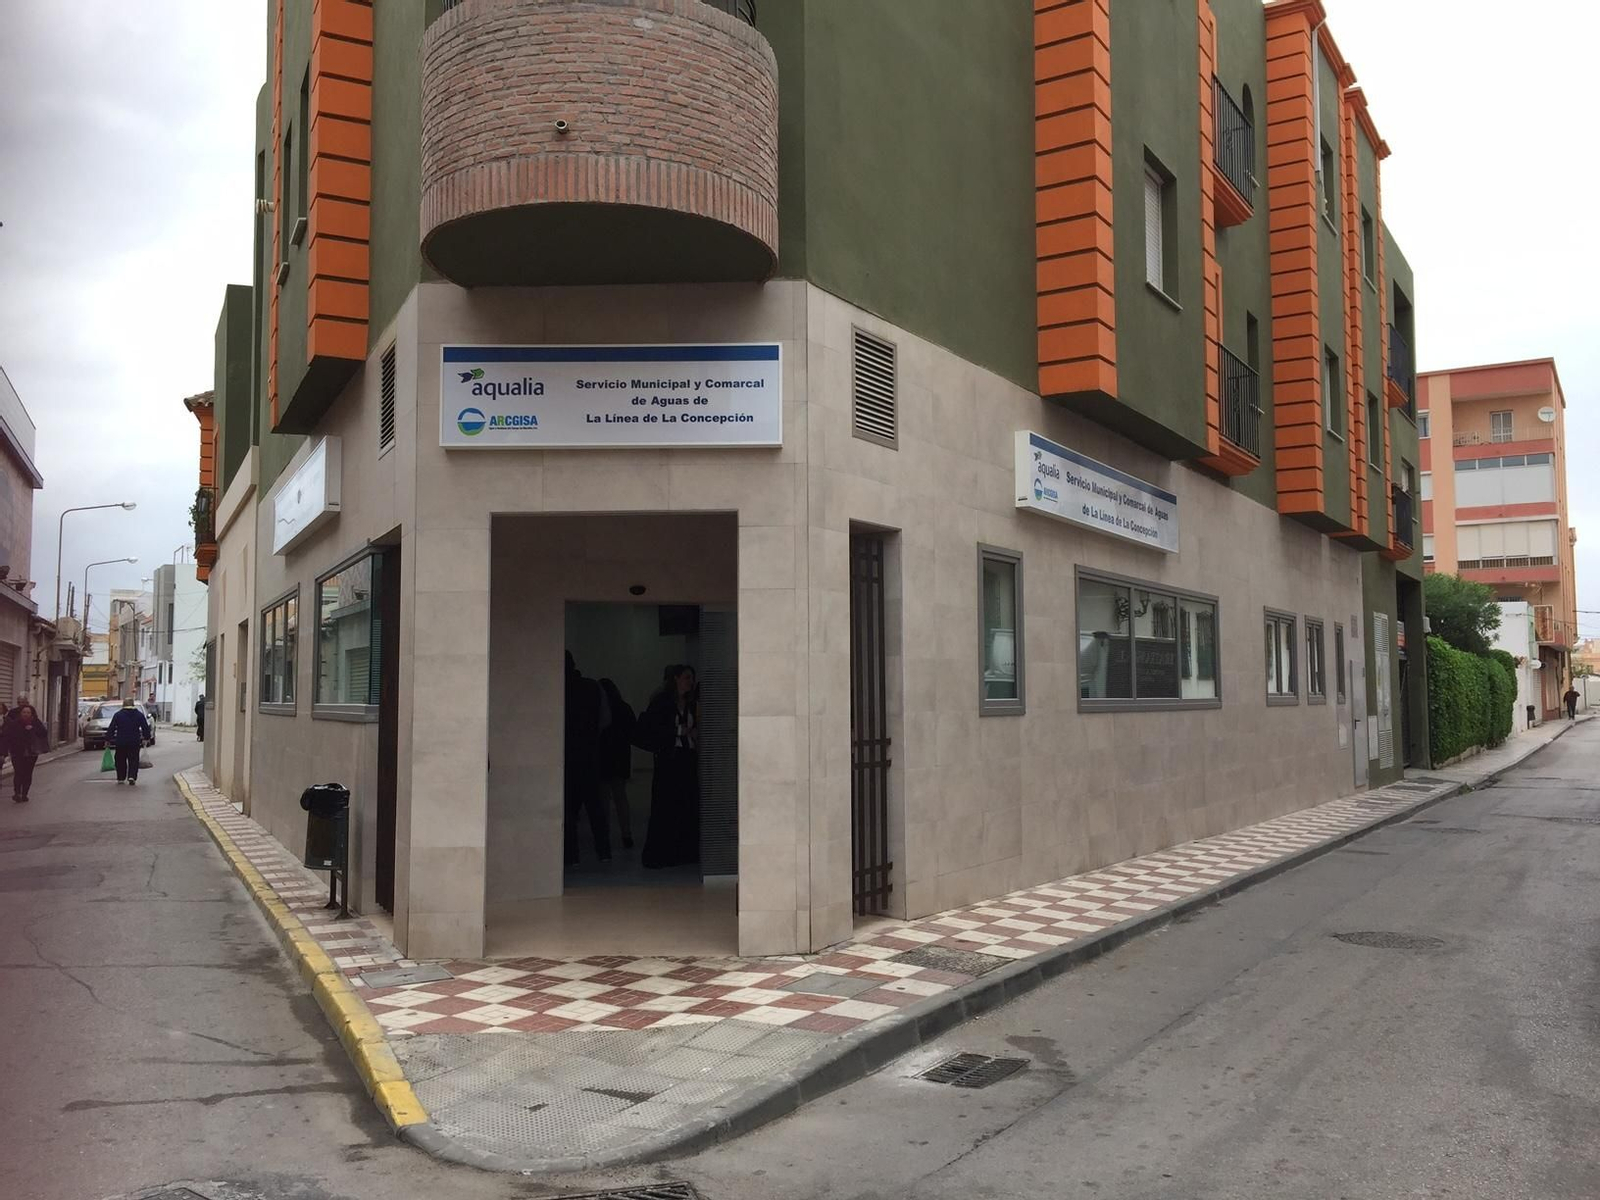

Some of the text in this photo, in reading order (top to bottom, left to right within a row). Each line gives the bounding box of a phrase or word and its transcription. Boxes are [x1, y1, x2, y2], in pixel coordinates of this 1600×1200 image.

[472, 377, 544, 400] aqualia
[576, 379, 765, 391] Servicio Municipal y Comarcal
[631, 396, 709, 407] de Aguas de
[490, 415, 538, 426] ARCGISA
[586, 413, 754, 424] La Línea de La Concepción
[1038, 461, 1059, 479] aqualia
[1066, 471, 1091, 491] Servicio
[1091, 481, 1119, 502] Municipal
[1122, 494, 1146, 512] Comarcal
[1147, 503, 1154, 516] de
[1155, 506, 1169, 521] Aguas
[1082, 503, 1090, 516] de
[1090, 505, 1099, 519] La
[1115, 514, 1122, 527] de
[1122, 517, 1130, 530] La
[1131, 520, 1158, 538] Concepción
